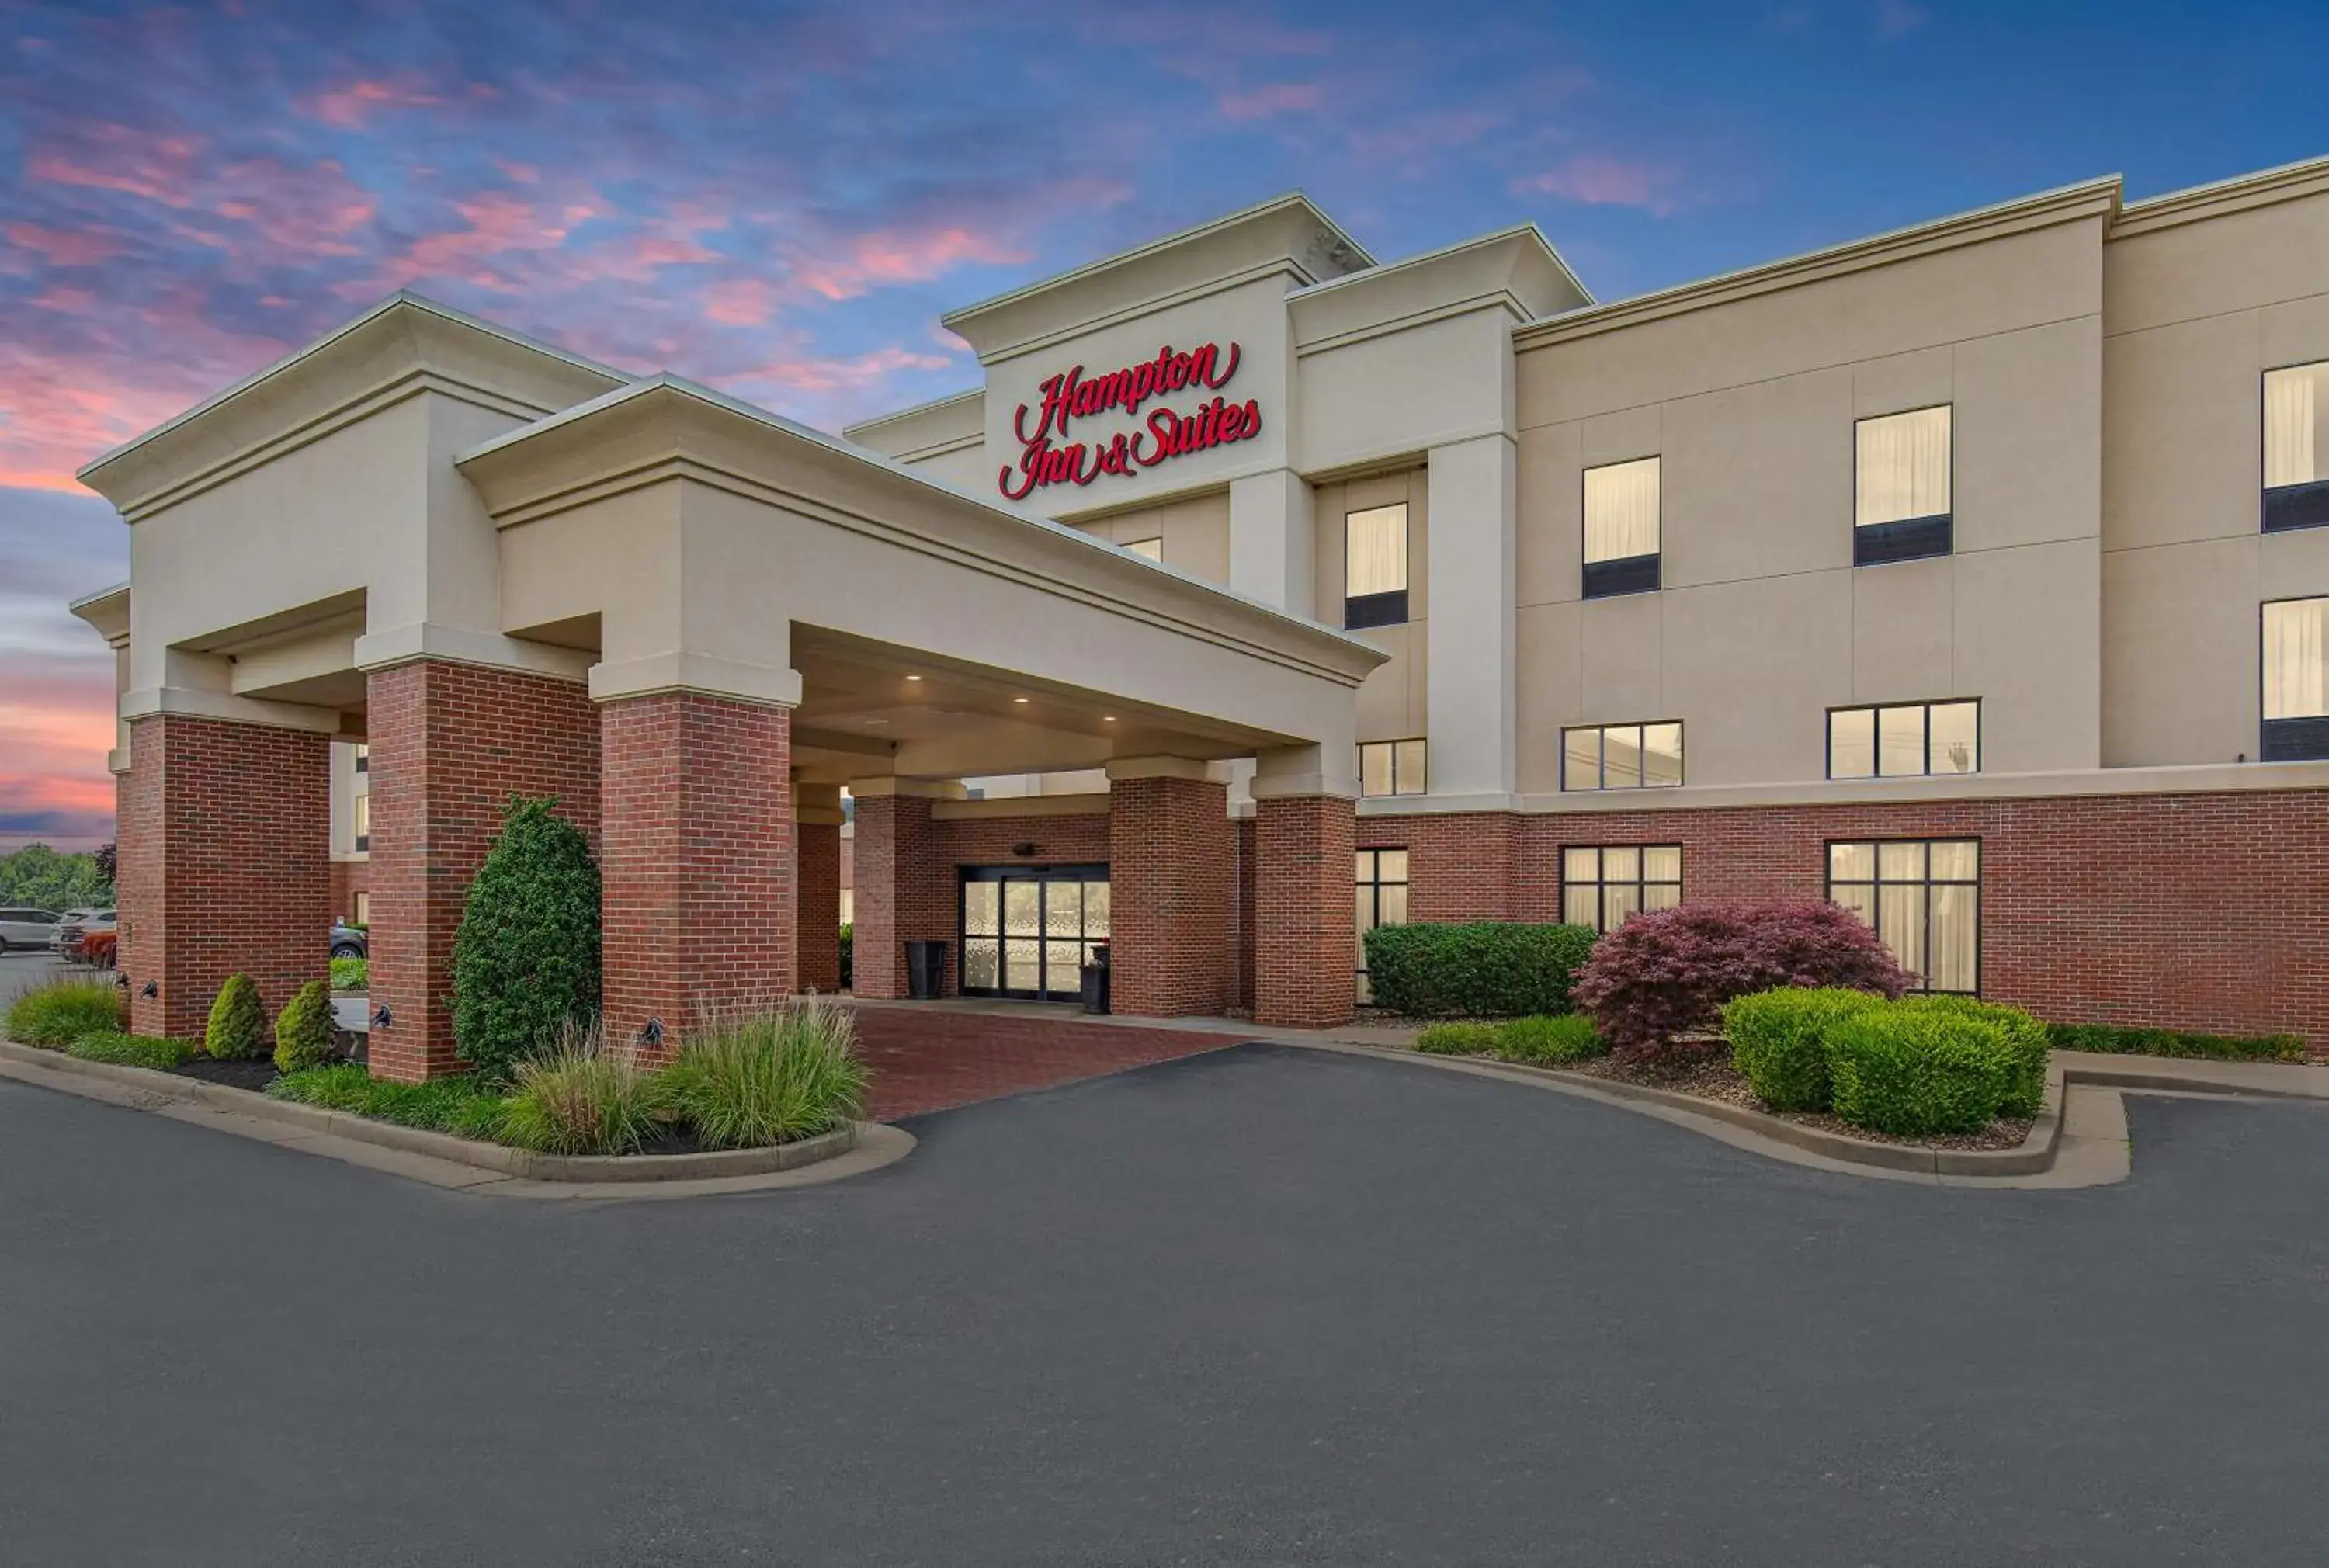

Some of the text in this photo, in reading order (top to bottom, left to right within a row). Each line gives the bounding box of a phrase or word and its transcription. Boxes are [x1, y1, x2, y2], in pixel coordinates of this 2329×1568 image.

[1015, 342, 1241, 445] Hampton
[999, 396, 1262, 501] Inn & Suites
